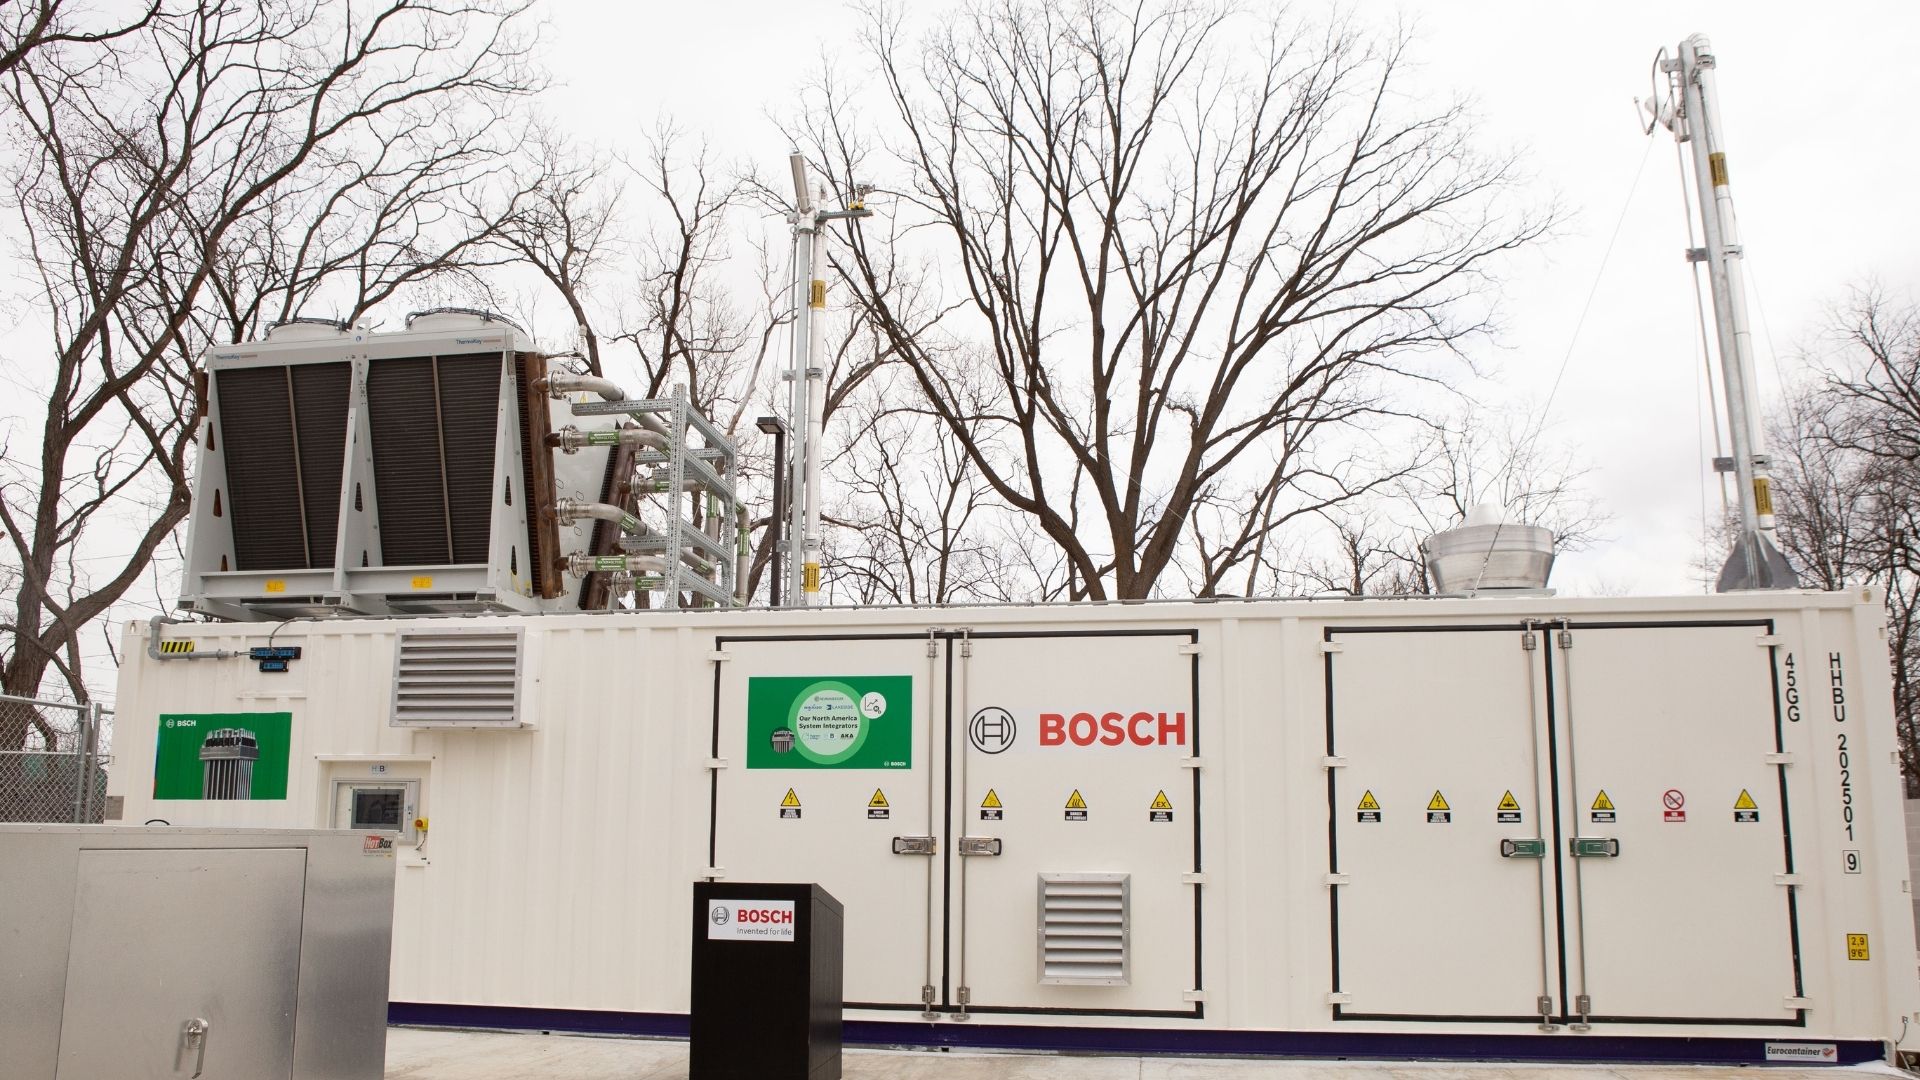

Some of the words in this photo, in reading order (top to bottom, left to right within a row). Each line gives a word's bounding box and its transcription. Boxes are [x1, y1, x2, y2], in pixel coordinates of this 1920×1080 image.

[1785, 652, 1800, 722] 45GG
[1039, 712, 1186, 746] BOSCH
[1829, 652, 1845, 722] HHBU
[1837, 734, 1853, 841] 202501
[1847, 853, 1857, 870] 9
[737, 909, 793, 923] BOSCH
[1767, 1046, 1821, 1056] Eurocontainer
